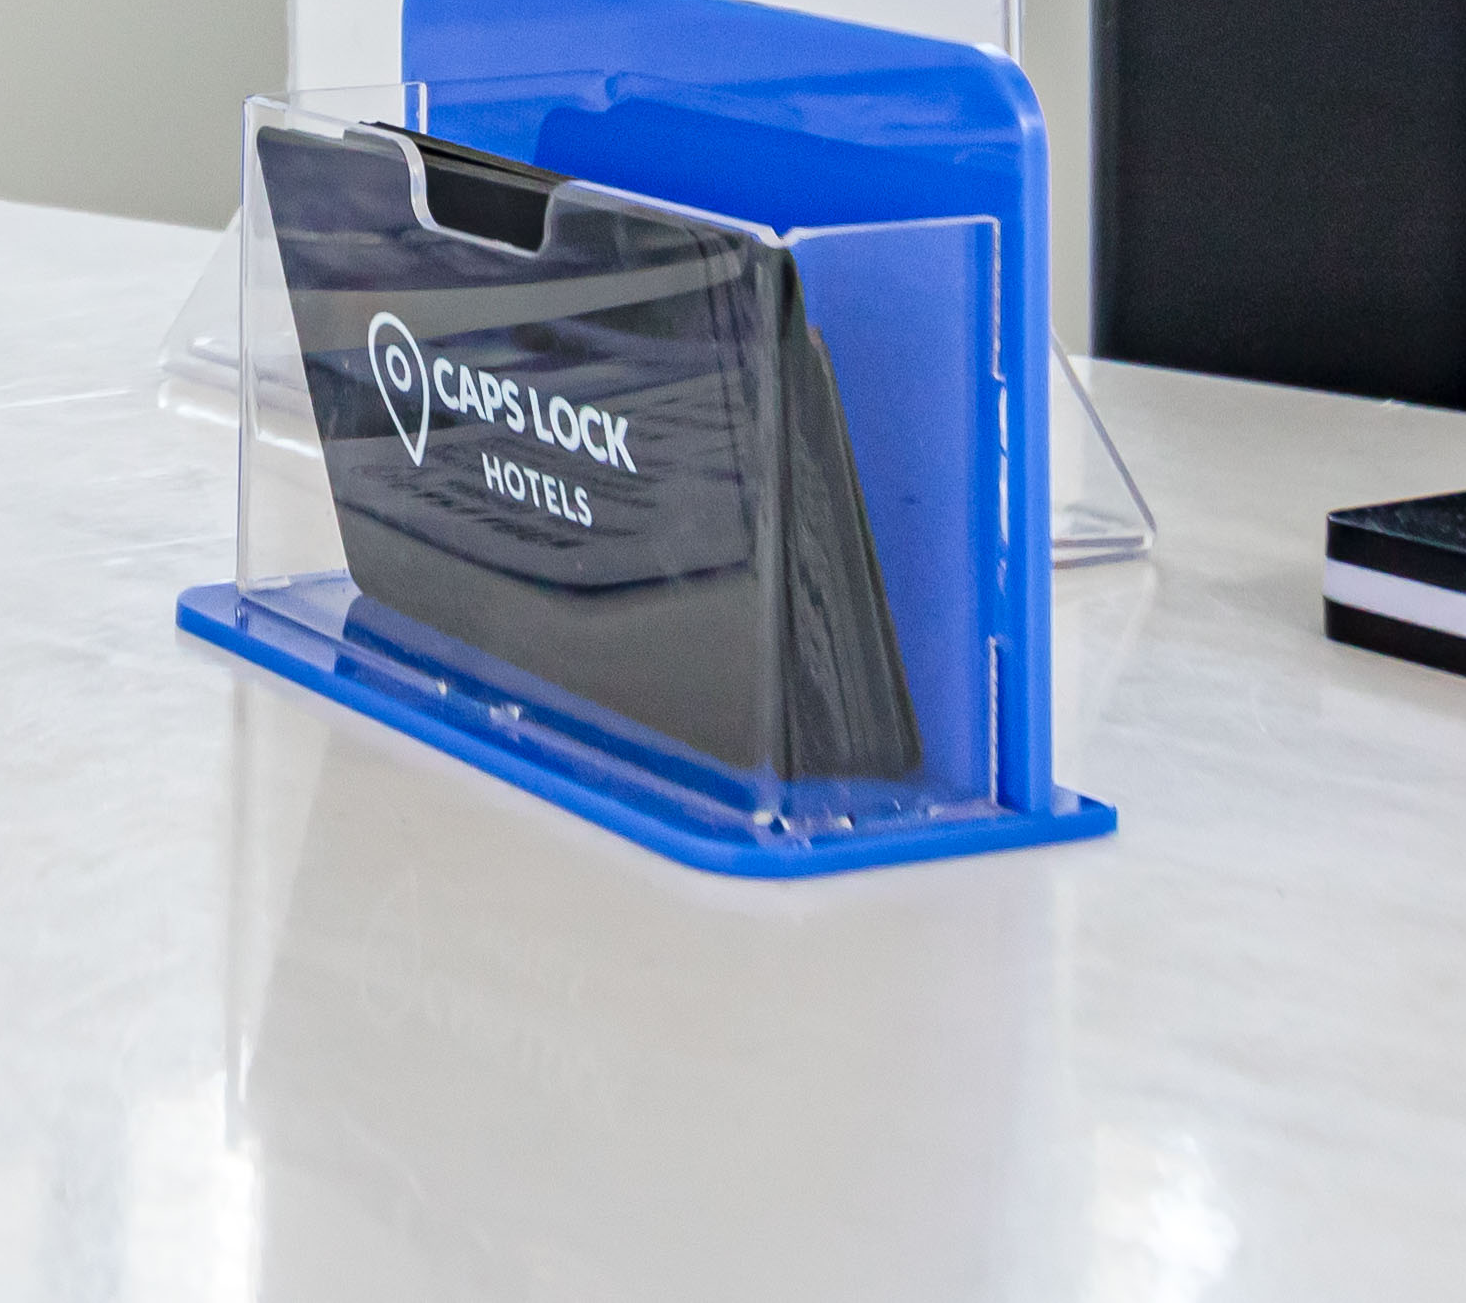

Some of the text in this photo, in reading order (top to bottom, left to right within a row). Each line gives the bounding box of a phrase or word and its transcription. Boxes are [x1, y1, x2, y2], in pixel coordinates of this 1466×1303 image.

[433, 357, 638, 473] CAPS LOCK
[482, 453, 592, 527] HOTELS
